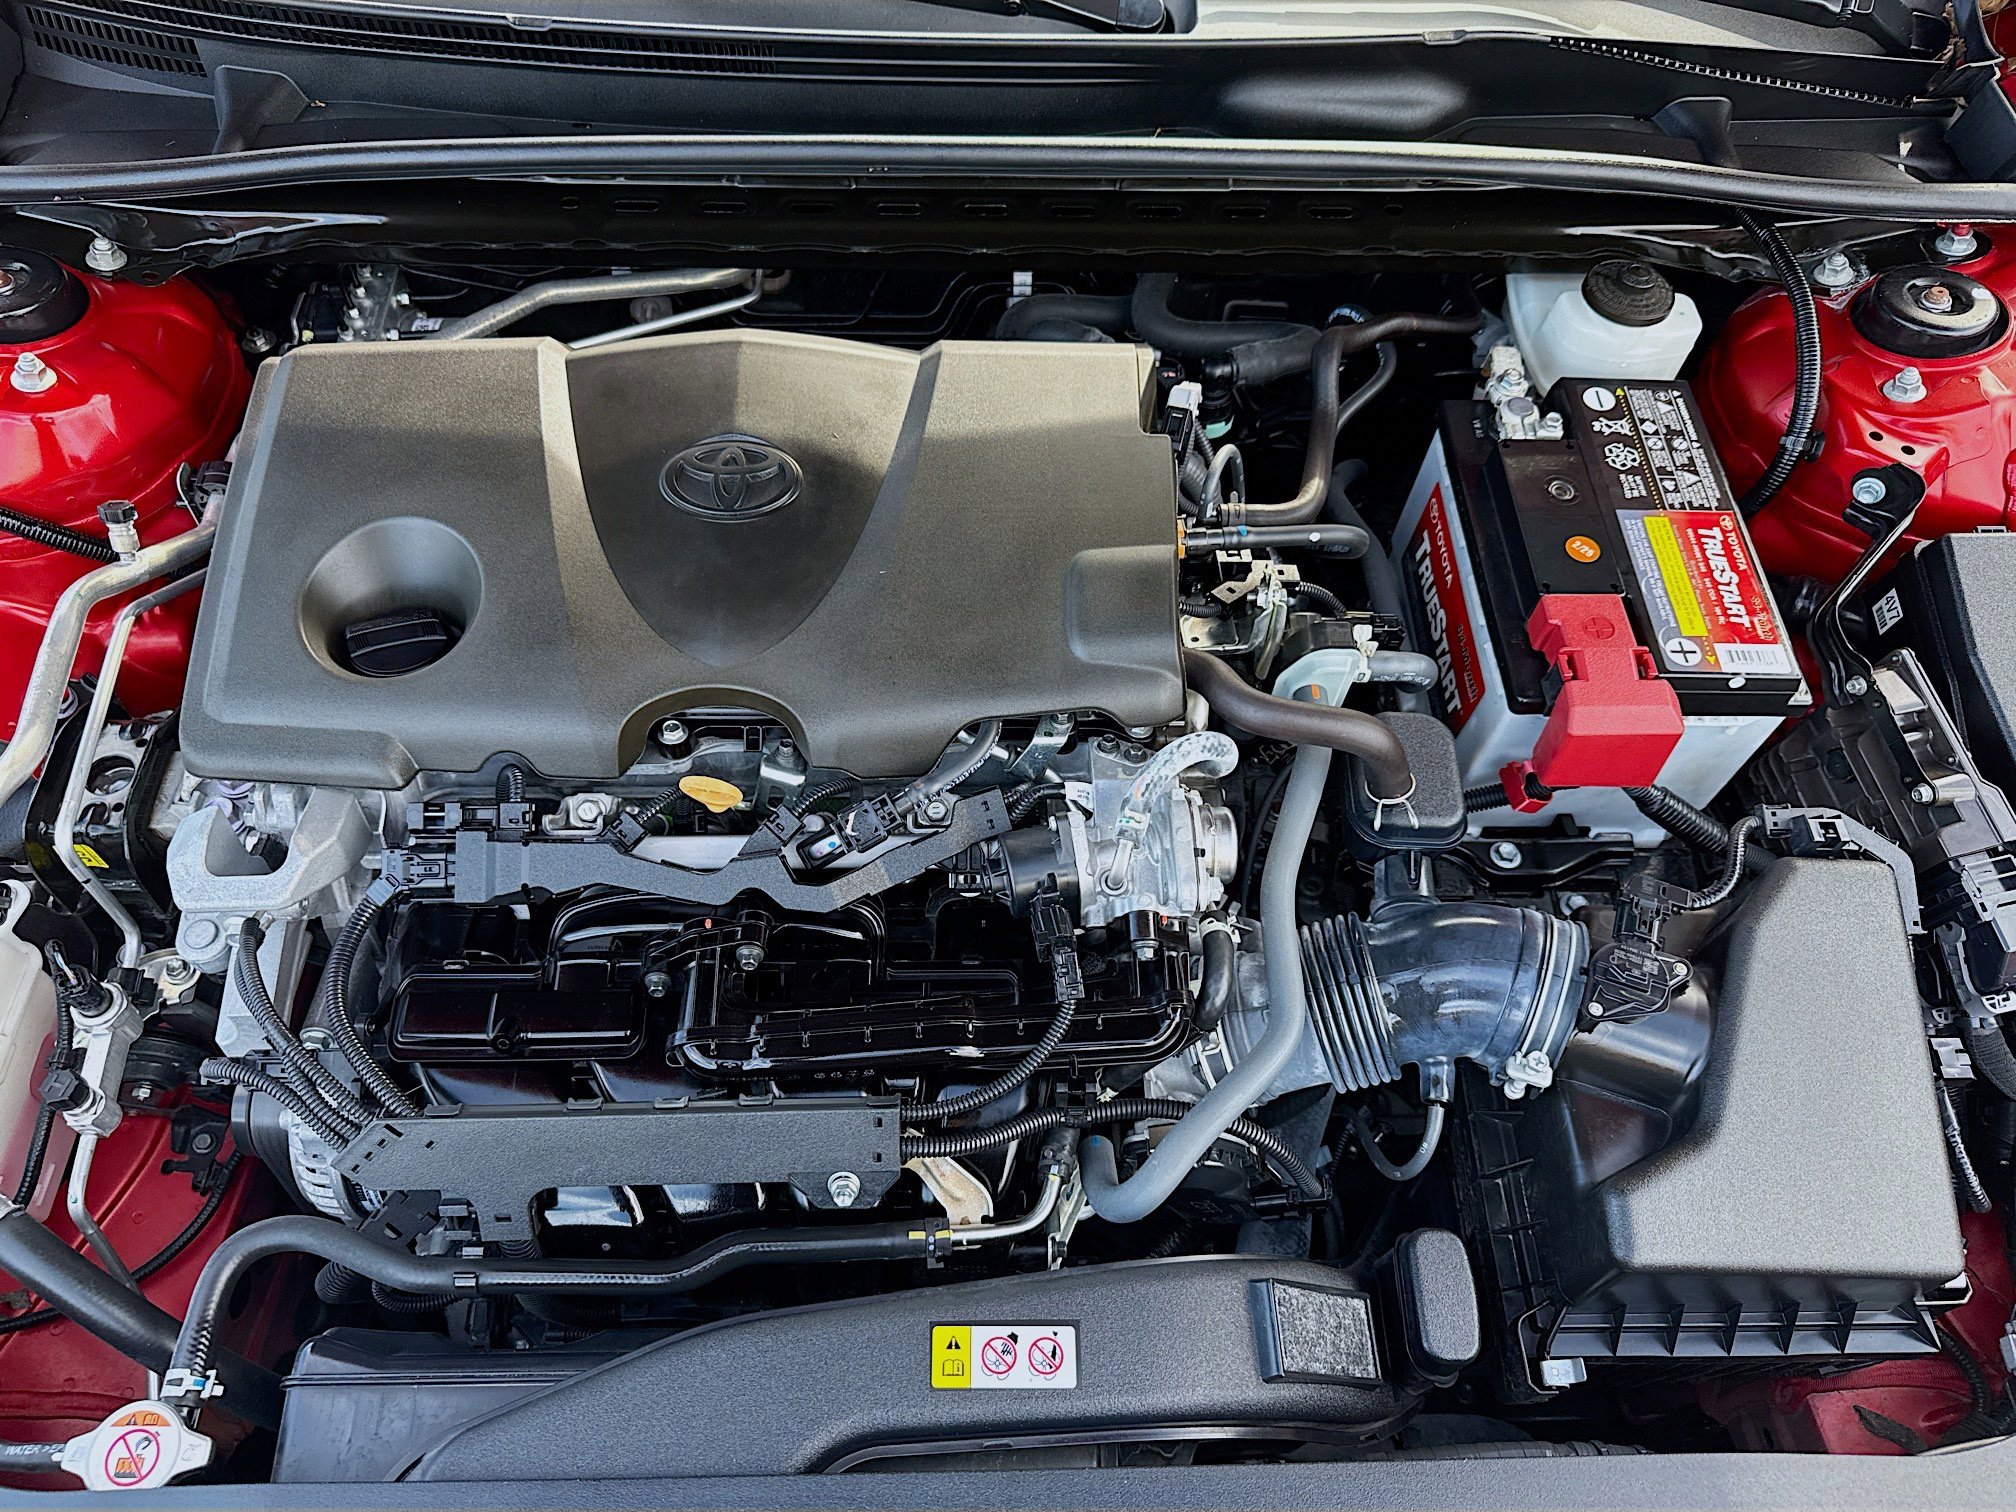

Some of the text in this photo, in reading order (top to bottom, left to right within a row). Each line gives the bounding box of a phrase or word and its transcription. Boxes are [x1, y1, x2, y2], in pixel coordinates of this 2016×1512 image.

[1436, 520, 1452, 588] TOYOTA
[1697, 527, 1751, 627] TRUESTART
[1724, 532, 1748, 570] TOYOTA
[1415, 529, 1461, 713] TRUESTART
[1884, 595, 1900, 621] 4V7
[5, 1444, 40, 1456] WATER
